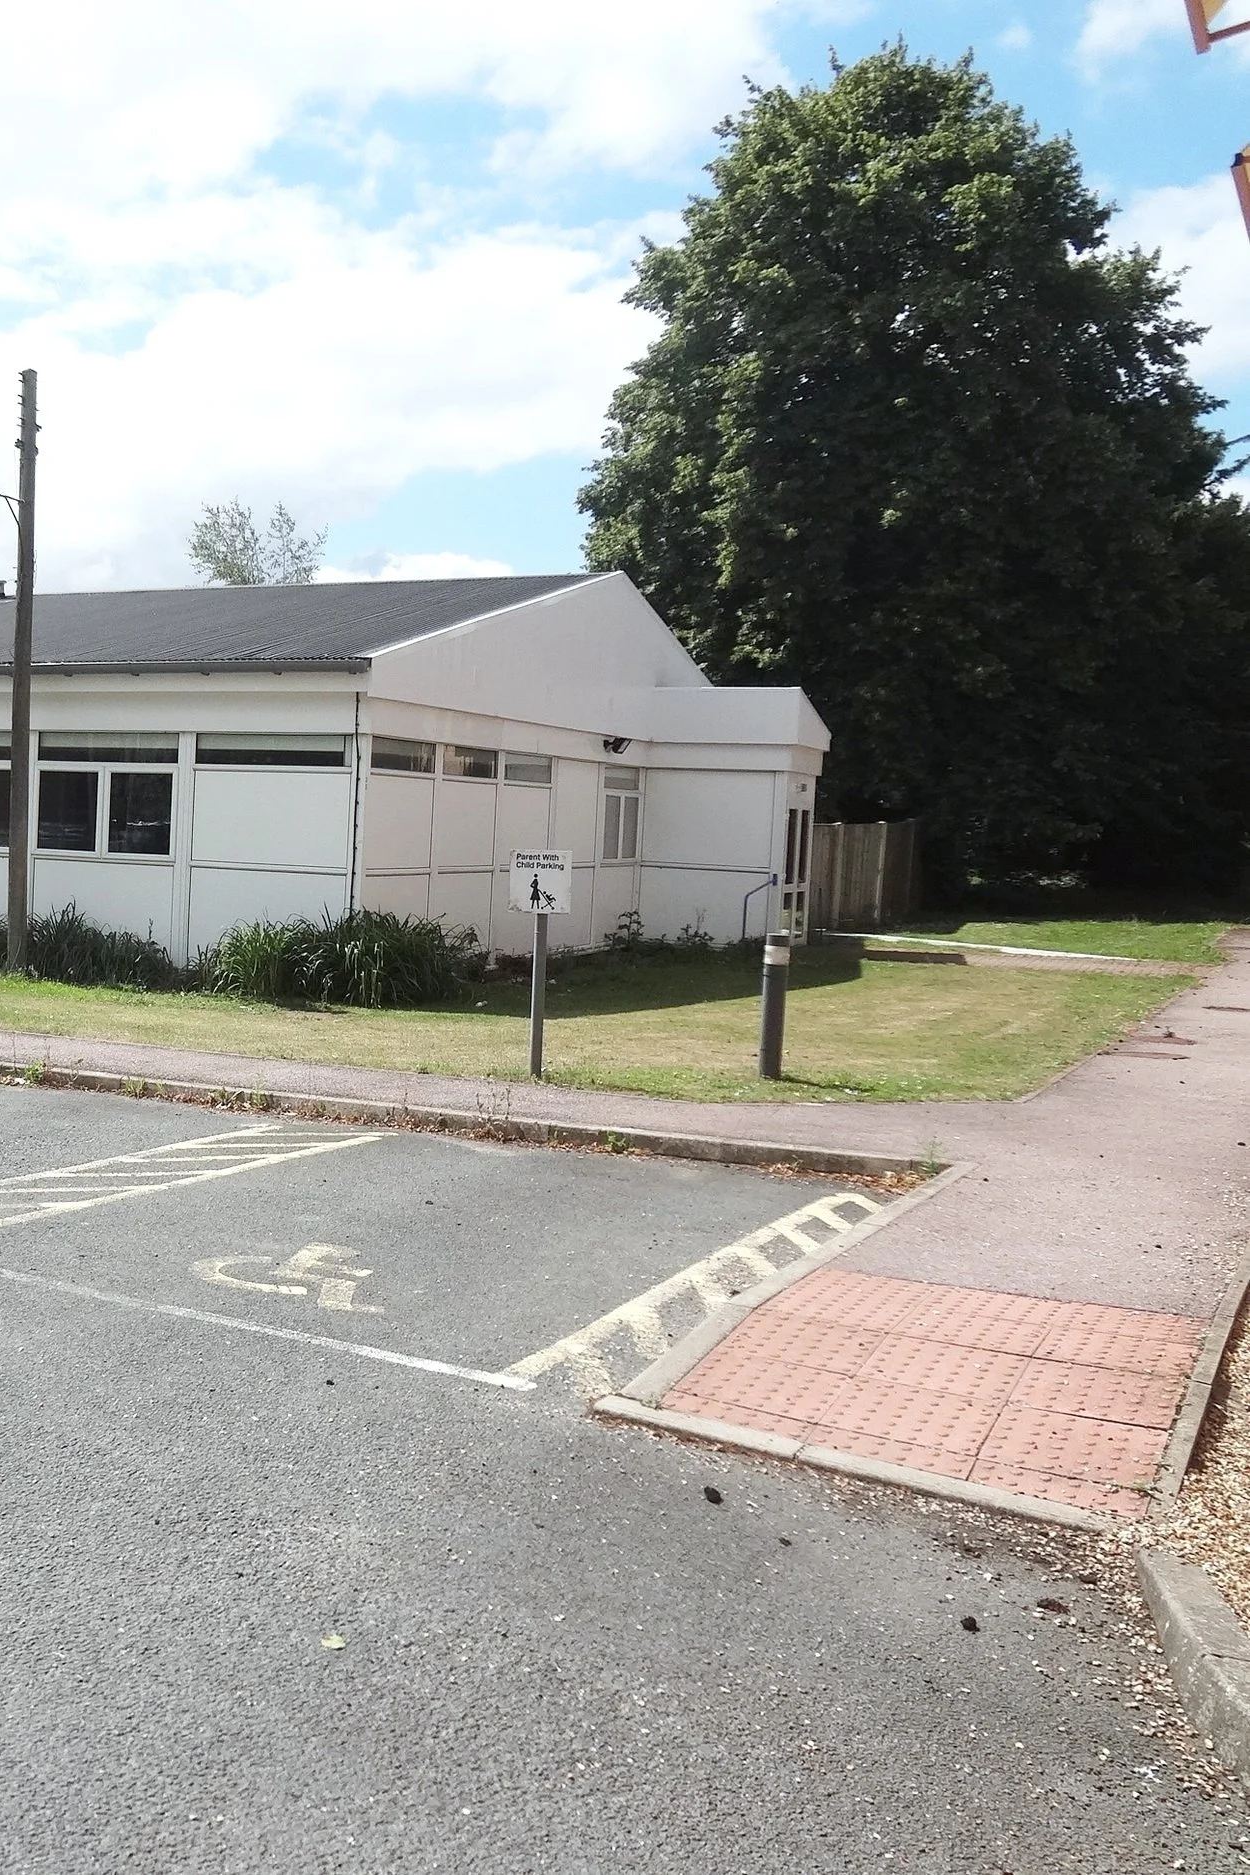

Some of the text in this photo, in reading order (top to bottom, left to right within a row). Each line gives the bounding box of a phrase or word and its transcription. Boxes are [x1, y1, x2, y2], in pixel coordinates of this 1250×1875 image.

[516, 853, 559, 861] Parent With
[516, 861, 565, 871] Child Parking
